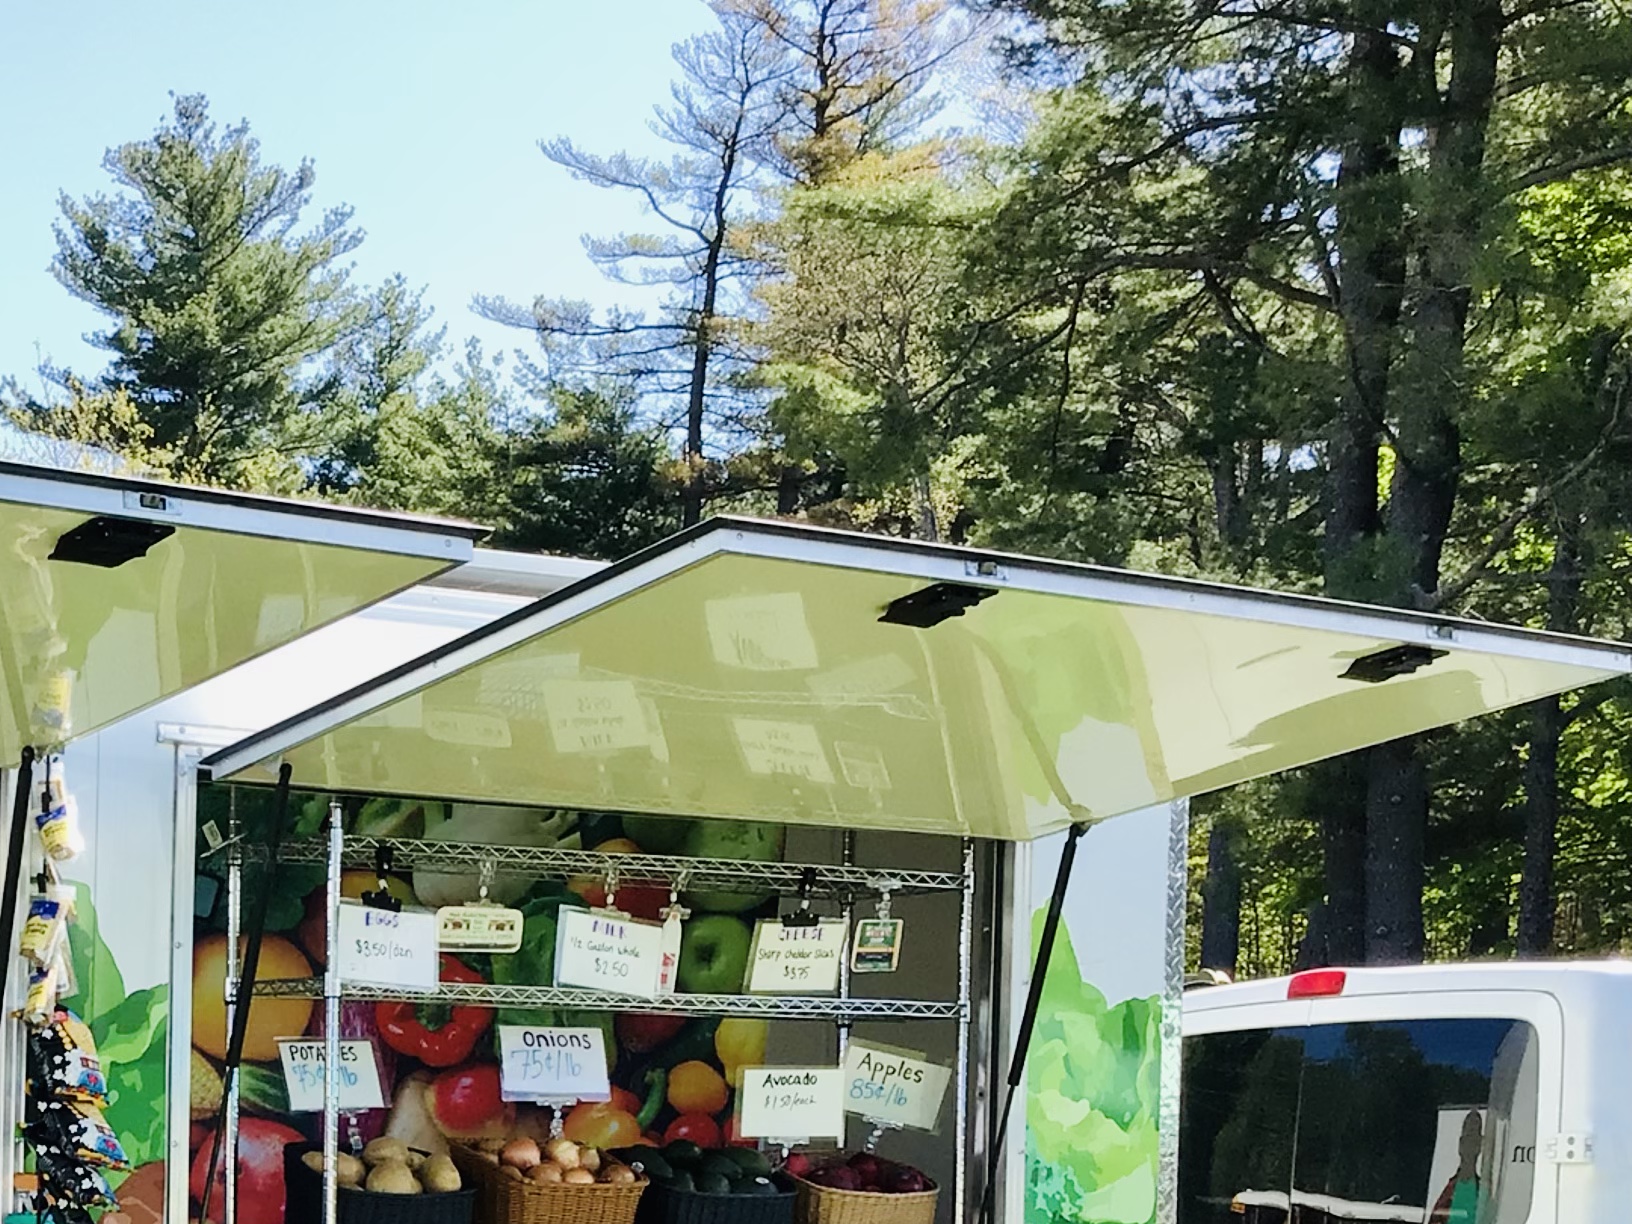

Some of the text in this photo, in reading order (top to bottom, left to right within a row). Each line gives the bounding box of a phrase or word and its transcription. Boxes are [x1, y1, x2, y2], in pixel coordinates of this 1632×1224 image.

[365, 911, 400, 928] EGGS
[523, 1030, 592, 1050] Onions
[289, 1045, 358, 1061] POTAES
[856, 1052, 924, 1085] Apples
[763, 1072, 818, 1088] Avocado
